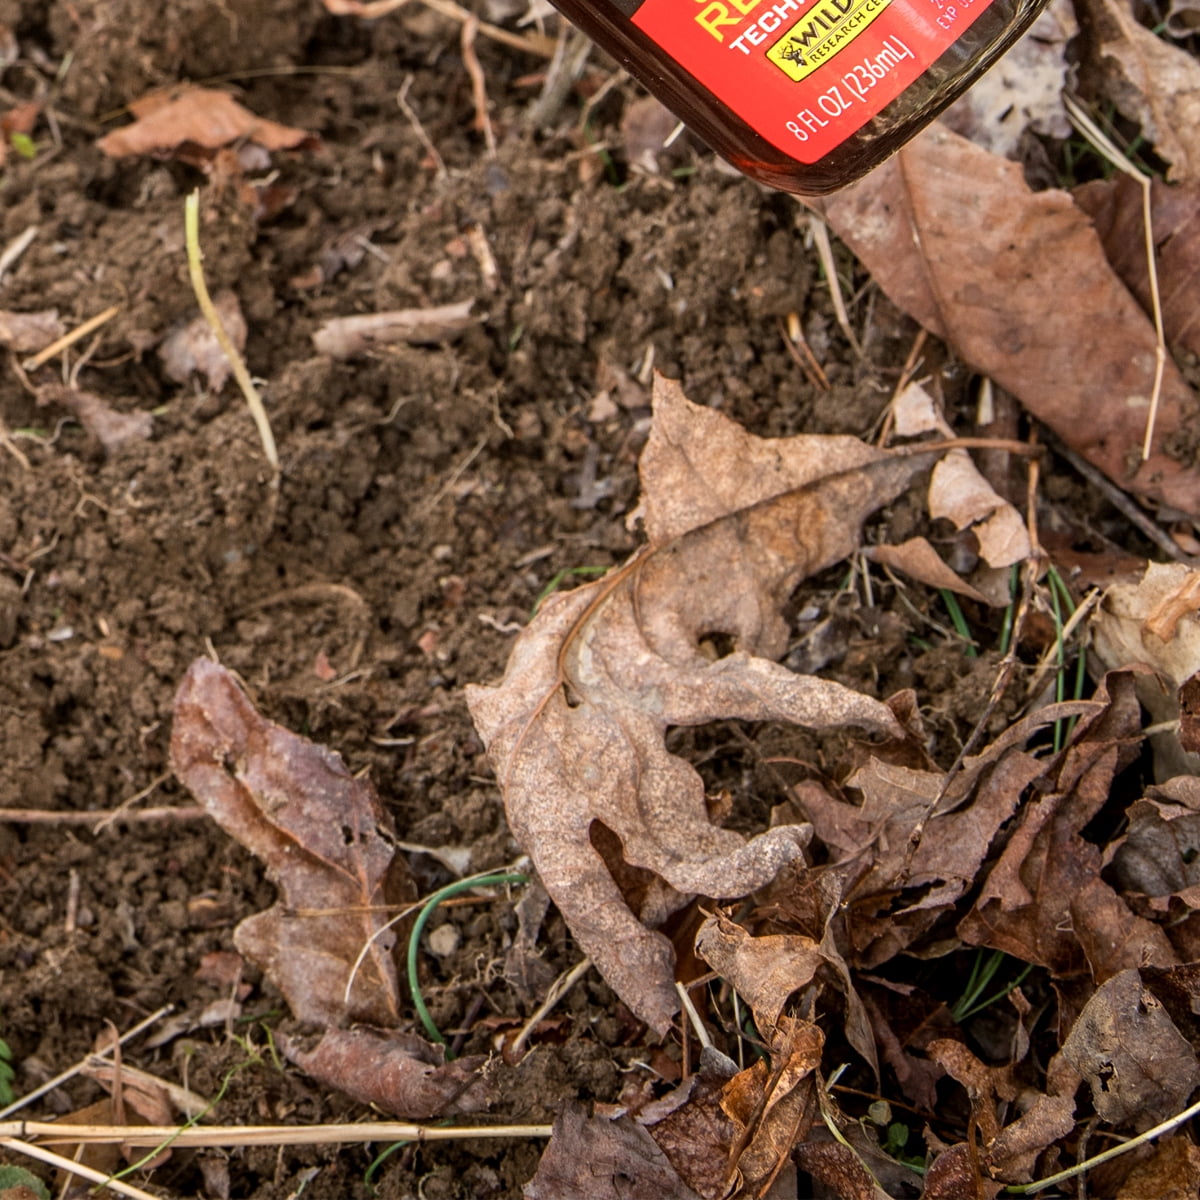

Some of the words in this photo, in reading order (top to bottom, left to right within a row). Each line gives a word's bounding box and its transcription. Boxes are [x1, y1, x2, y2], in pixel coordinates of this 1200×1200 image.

[809, 12, 866, 64] RESEARCH
[936, 6, 958, 30] EXP
[785, 120, 809, 142] 8
[797, 108, 830, 133] FL
[817, 86, 853, 118] OZ
[840, 35, 916, 103] (236mL)
